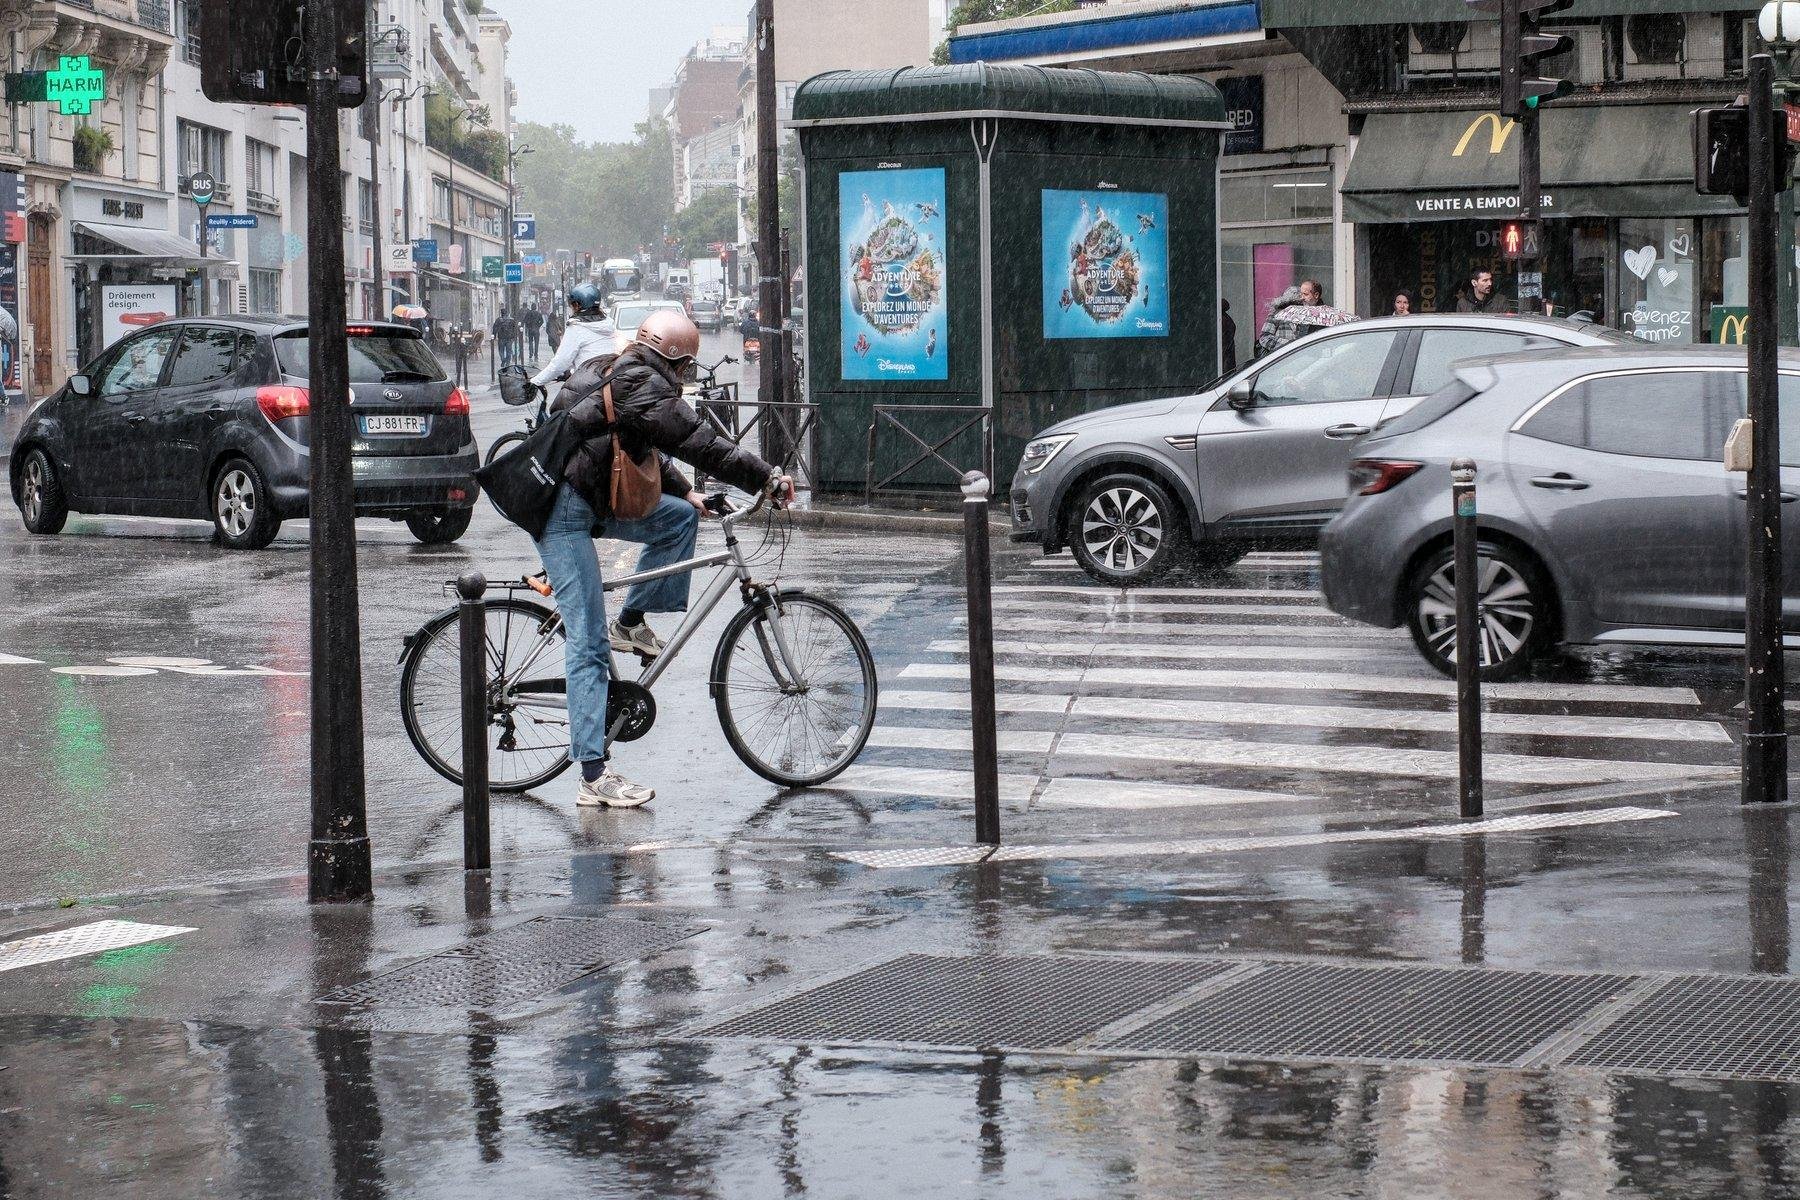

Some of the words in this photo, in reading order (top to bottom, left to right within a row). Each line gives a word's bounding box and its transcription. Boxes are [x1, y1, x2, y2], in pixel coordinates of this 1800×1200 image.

[1225, 109, 1254, 125] RED
[192, 179, 212, 190] BUS
[1416, 199, 1461, 211] VENTE
[1464, 198, 1474, 209] A
[517, 222, 529, 237] P
[871, 271, 921, 282] ADVENTURE
[108, 291, 156, 300] Drôlement
[862, 302, 894, 312] EXPLOREZ
[895, 302, 905, 312] UN
[906, 301, 931, 312] MONDE
[874, 313, 919, 324] D'AVENTURES
[1623, 310, 1691, 325] revenez
[1625, 325, 1682, 342] omme
[367, 417, 418, 430] CJ-881-FR
